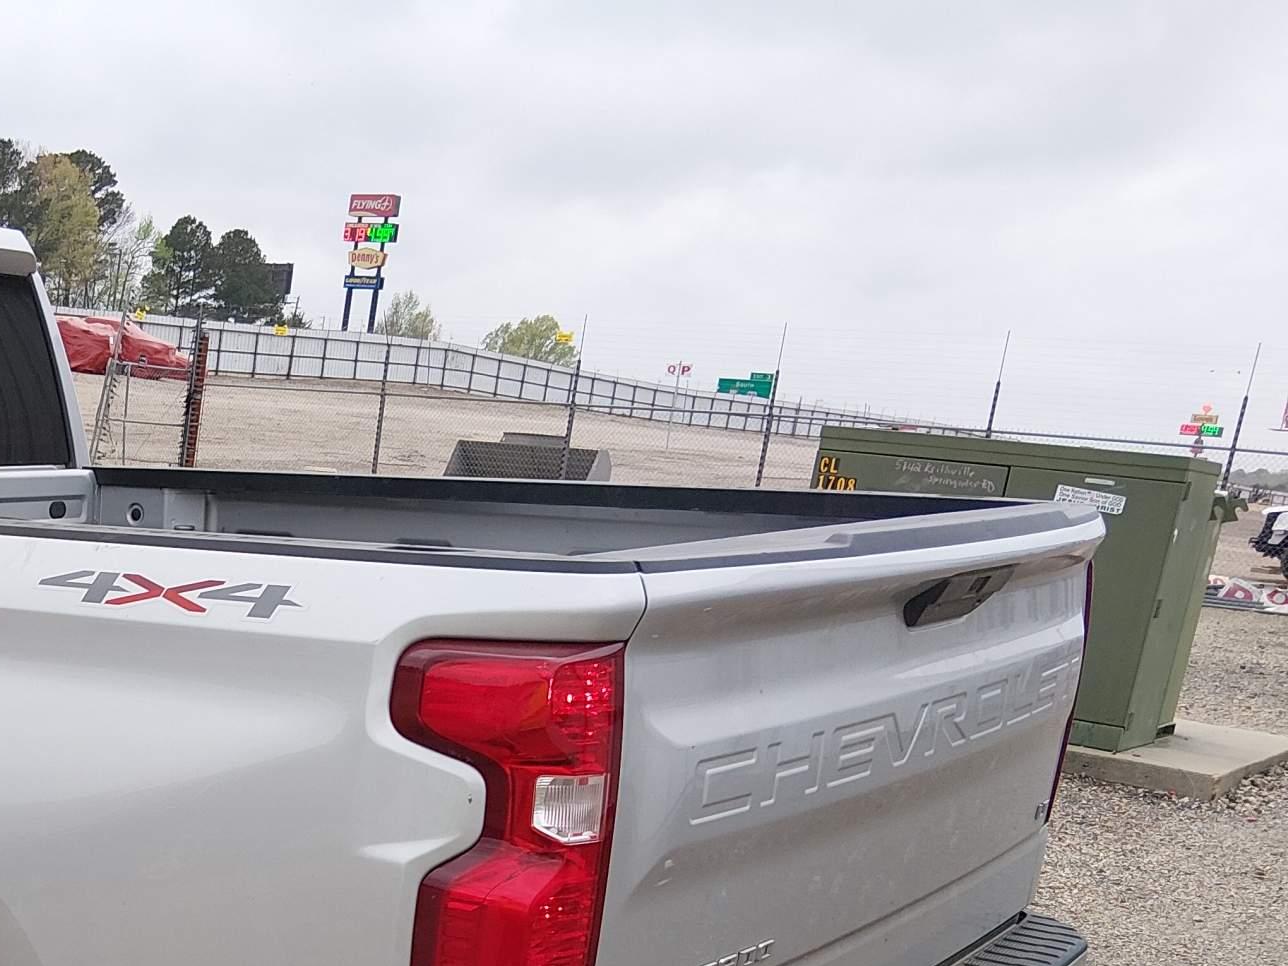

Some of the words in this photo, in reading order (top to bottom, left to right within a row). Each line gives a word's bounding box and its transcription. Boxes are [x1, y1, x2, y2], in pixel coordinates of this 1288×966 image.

[352, 199, 381, 210] FLYING
[352, 252, 380, 264] Denny's
[667, 364, 676, 375] Q
[681, 365, 691, 376] P
[820, 456, 838, 473] CL
[817, 475, 856, 491] 1708
